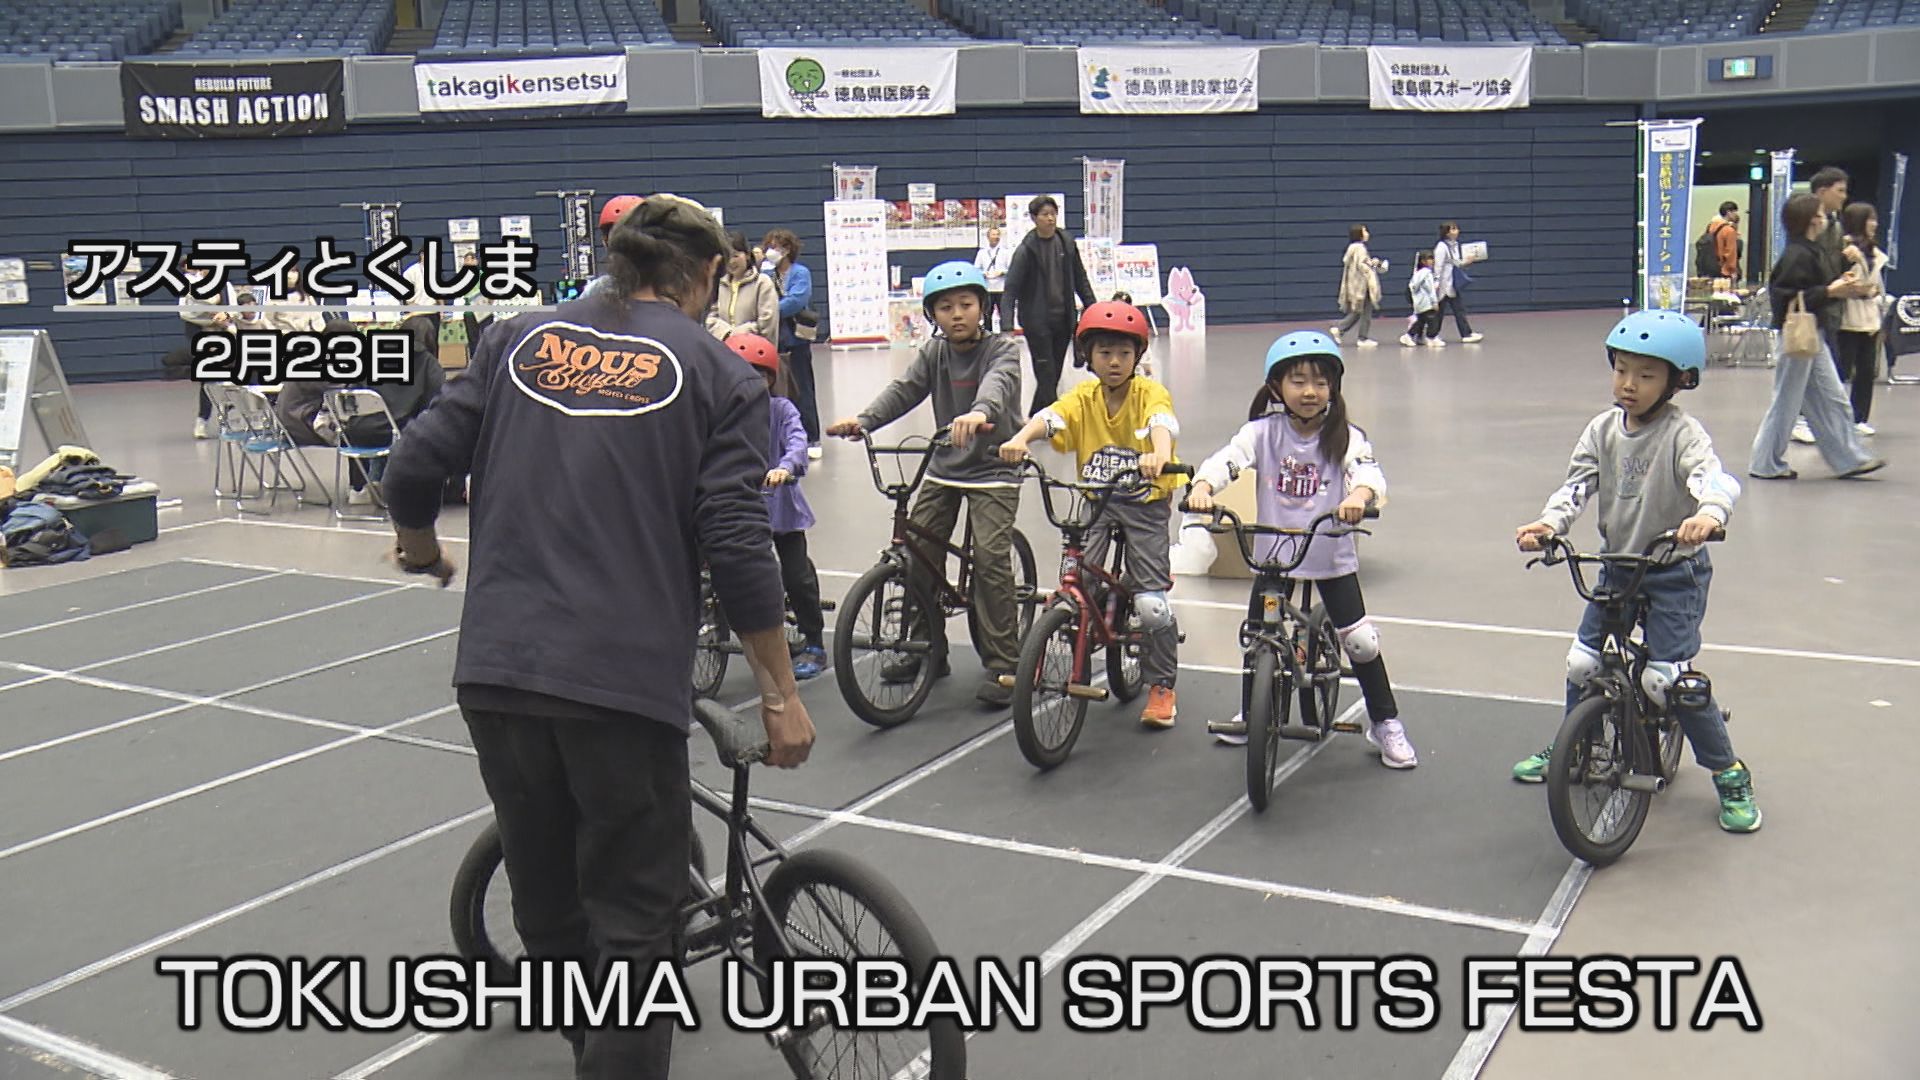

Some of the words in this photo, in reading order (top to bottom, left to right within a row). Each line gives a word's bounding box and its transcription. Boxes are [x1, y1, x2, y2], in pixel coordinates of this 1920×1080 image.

[1391, 64, 1451, 76] 公益財団法人
[236, 77, 273, 91] FUTURE
[427, 71, 618, 100] takagikensetsu
[834, 84, 931, 102] 徳島県医師会
[1124, 77, 1254, 97] 徳島県建設業協会
[1391, 79, 1513, 97] 徳島県スポーツ協会
[139, 95, 230, 125] SMASH
[237, 93, 329, 125] ACTION
[575, 199, 588, 237] Love
[535, 333, 662, 379] NOUS
